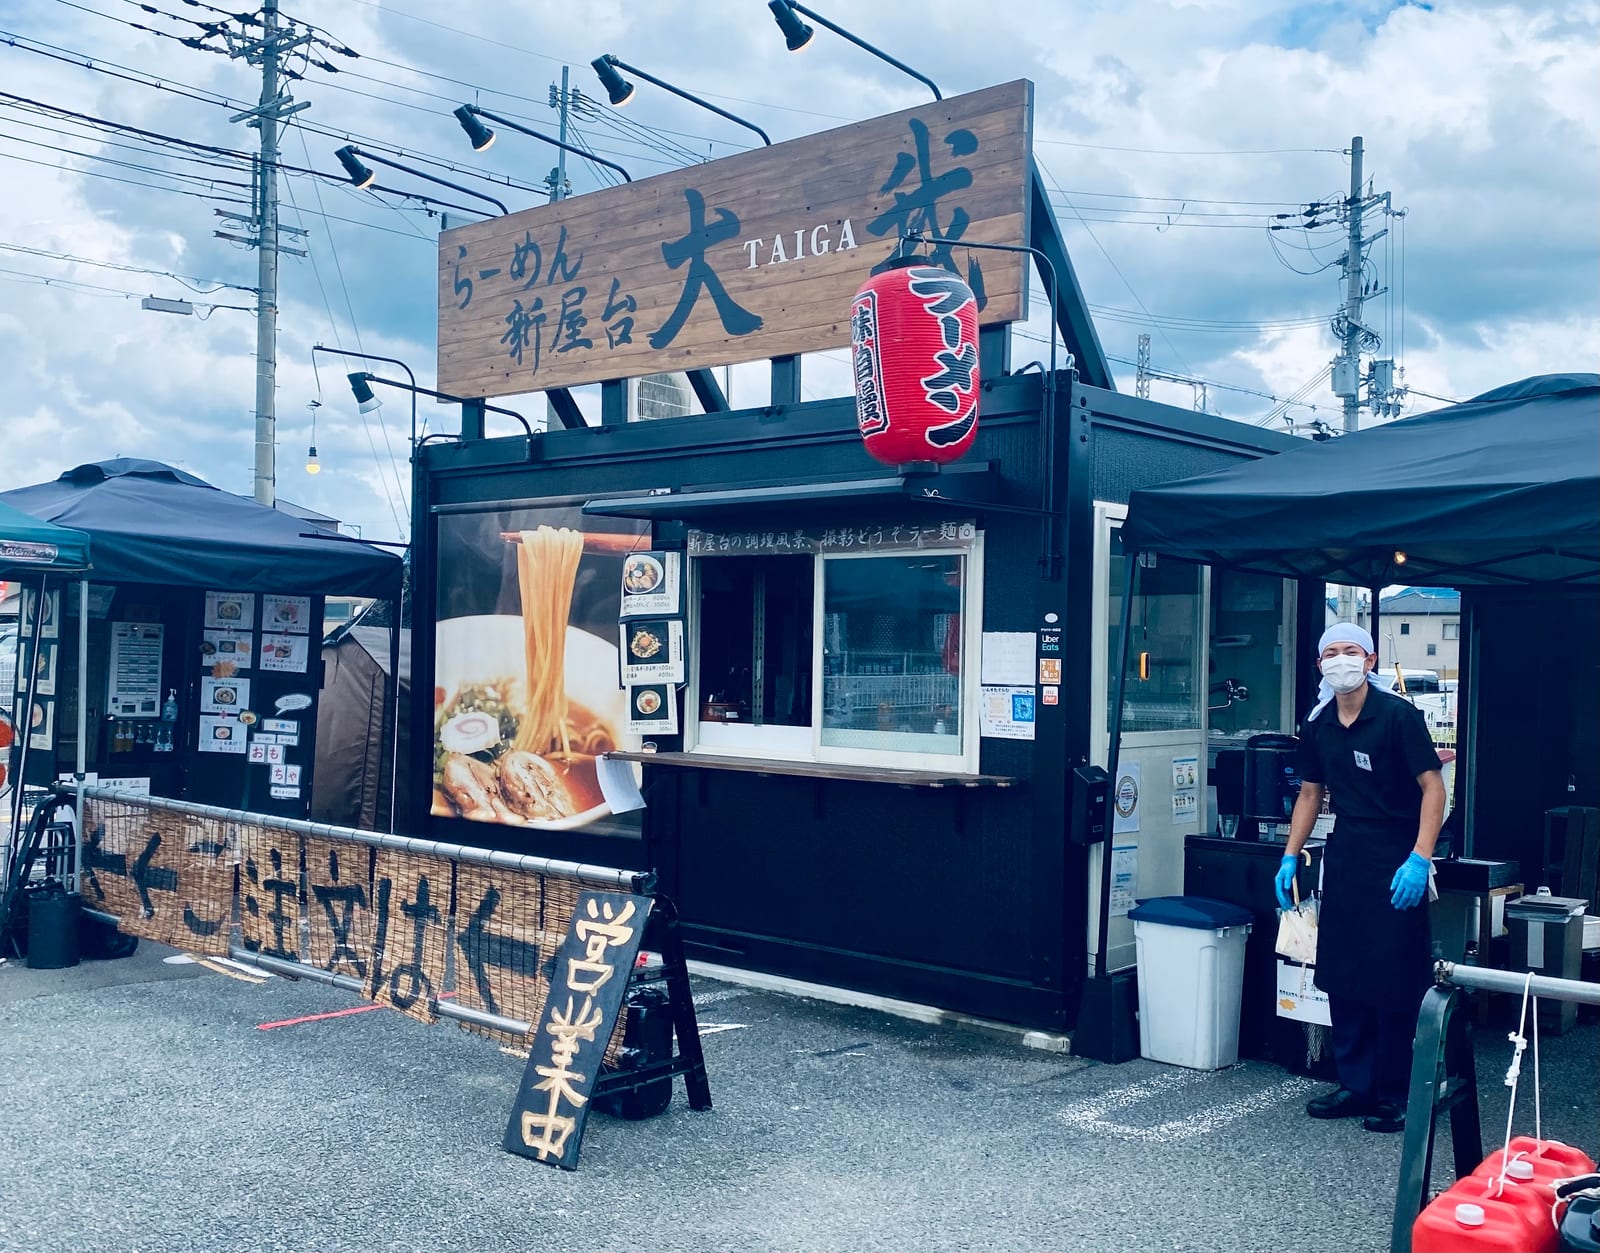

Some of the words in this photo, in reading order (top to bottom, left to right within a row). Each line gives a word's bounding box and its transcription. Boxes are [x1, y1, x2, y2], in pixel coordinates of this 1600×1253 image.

[453, 226, 584, 311] らーめん
[649, 187, 764, 351] 大
[742, 219, 858, 271] TAIGA
[500, 277, 638, 376] 新屋台
[907, 268, 978, 448] ラーメン
[1042, 634, 1059, 643] Uber
[1042, 643, 1059, 651] Eats
[252, 746, 279, 760] おも
[183, 839, 442, 1011] ご注文は
[520, 897, 636, 1162] 営業中
